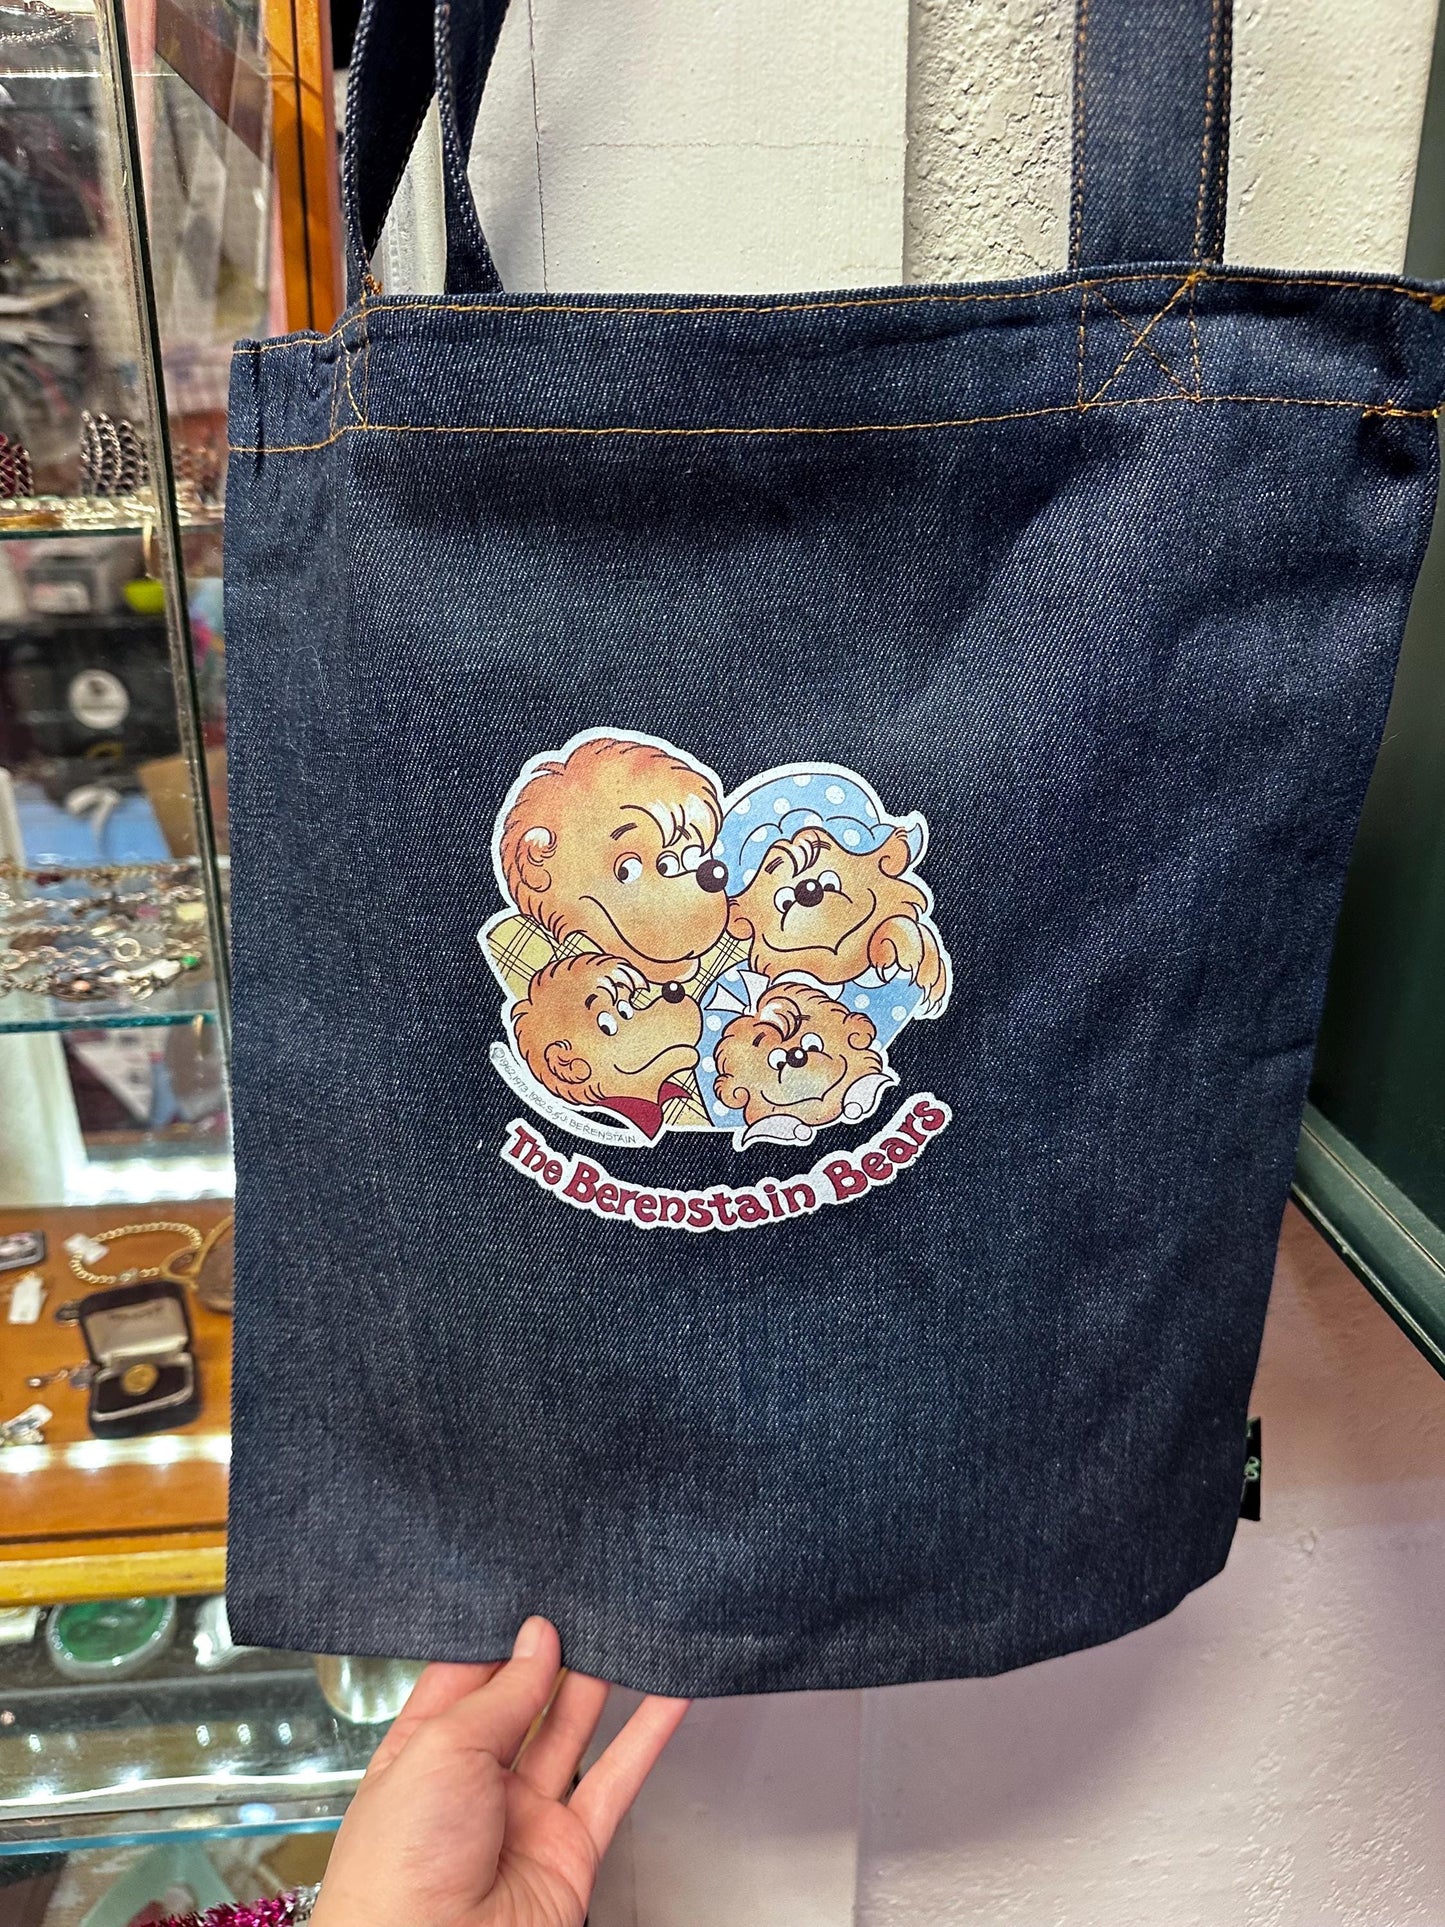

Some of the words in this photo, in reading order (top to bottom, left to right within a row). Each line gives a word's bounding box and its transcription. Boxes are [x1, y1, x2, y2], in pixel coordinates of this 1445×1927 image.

[509, 1125, 562, 1186] The
[564, 1162, 817, 1228] Berenstain
[824, 1099, 952, 1201] Bears
[569, 1118, 637, 1144] BERENSTAIN
